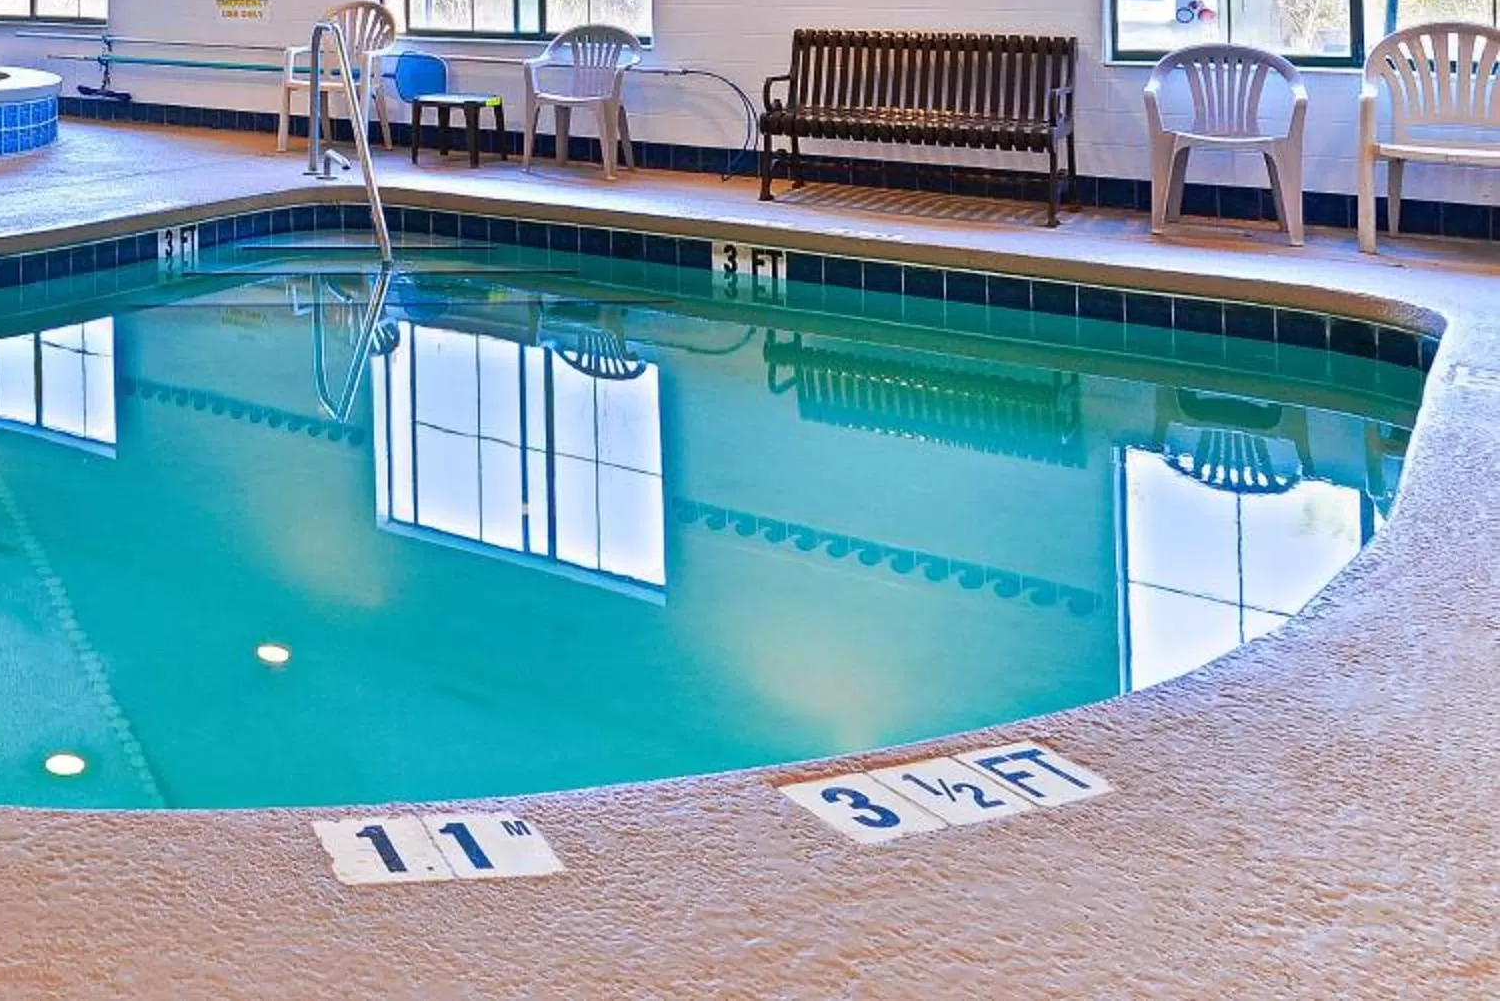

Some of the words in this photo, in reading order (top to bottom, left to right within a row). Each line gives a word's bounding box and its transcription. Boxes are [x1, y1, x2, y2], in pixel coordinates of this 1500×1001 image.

[165, 228, 173, 256] 3
[181, 225, 197, 256] FT
[723, 245, 738, 273] 3
[751, 248, 784, 279] FT
[820, 786, 902, 828] 3
[972, 748, 1092, 799] FT
[501, 820, 532, 837] M
